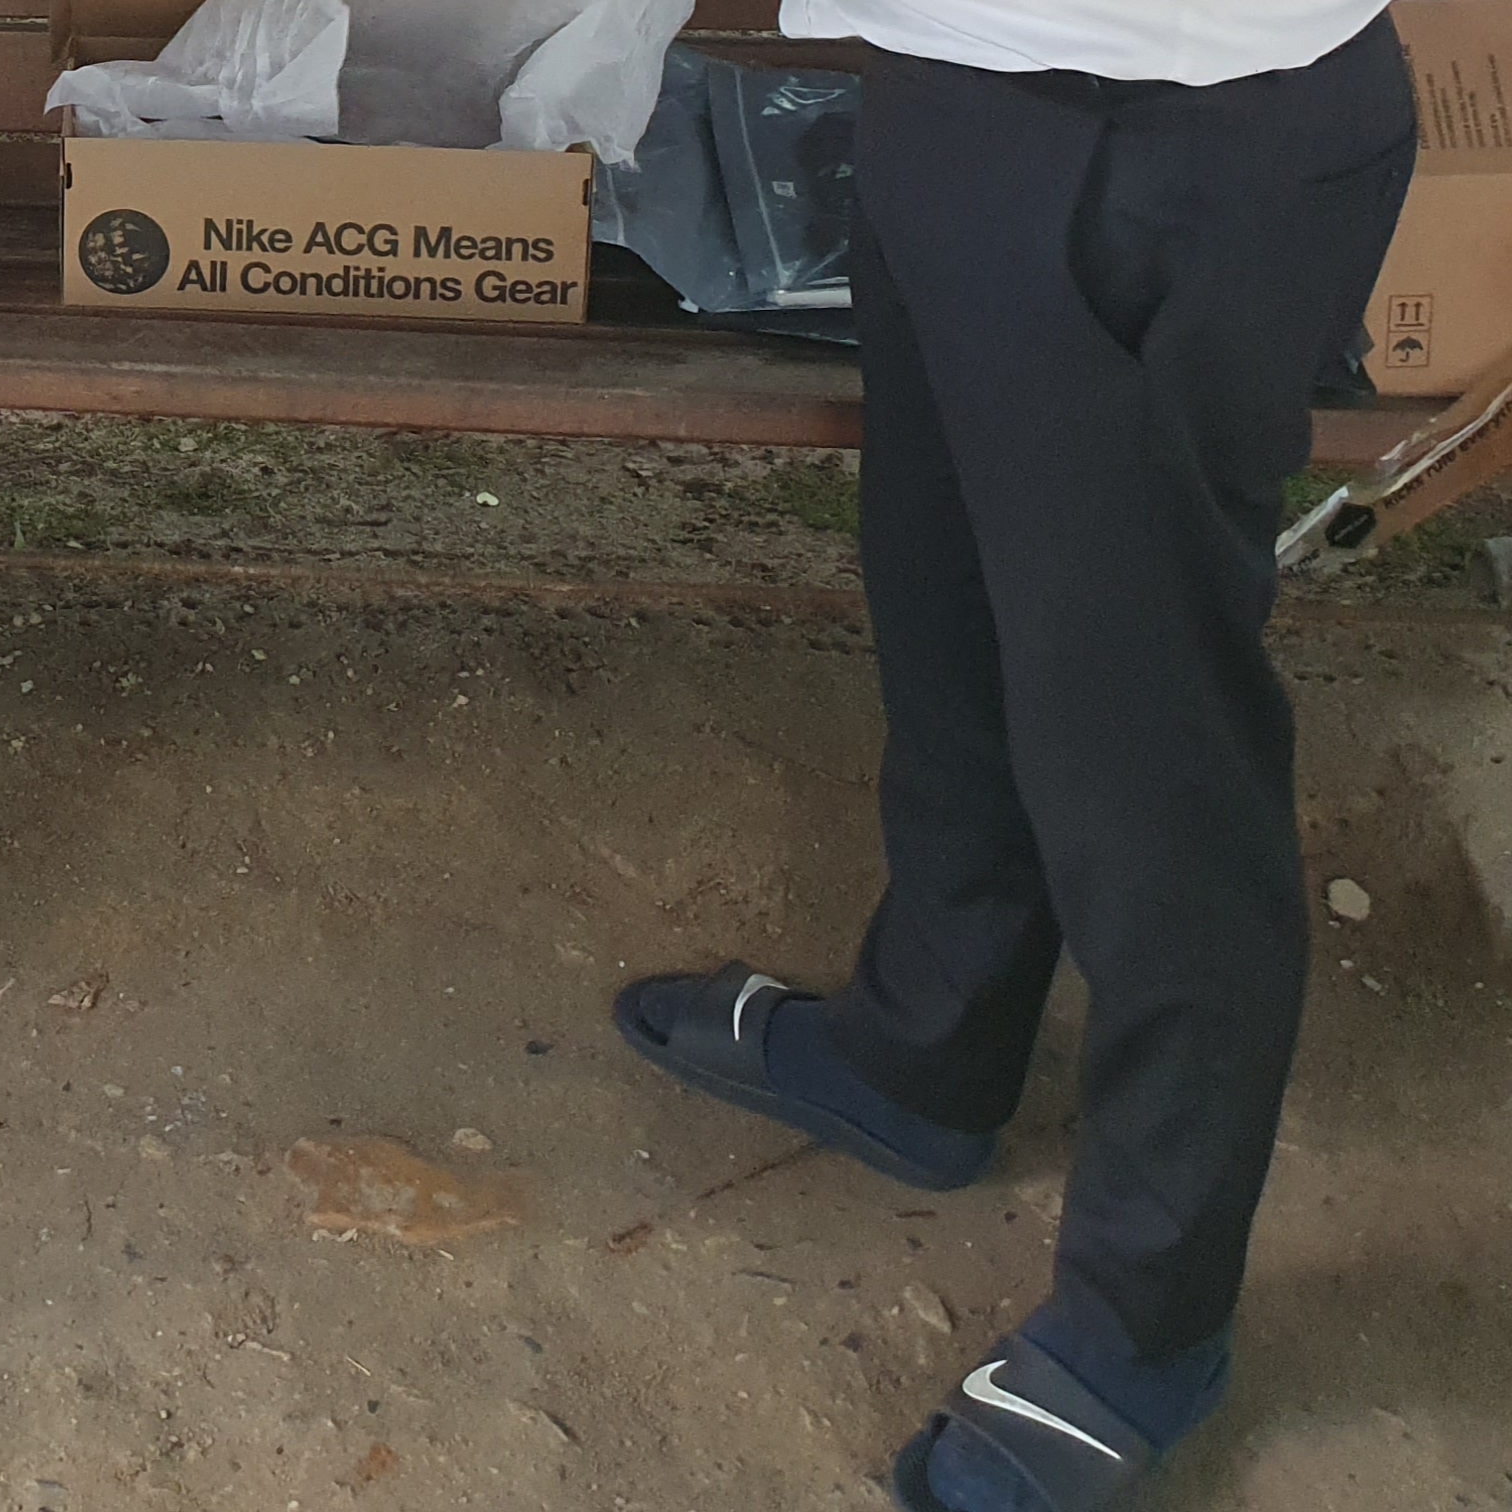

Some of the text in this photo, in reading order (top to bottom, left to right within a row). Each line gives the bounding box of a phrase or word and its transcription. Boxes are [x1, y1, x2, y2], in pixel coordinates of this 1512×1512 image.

[203, 217, 555, 264] Nike ACG Means
[176, 259, 579, 307] All Conditions Gear
